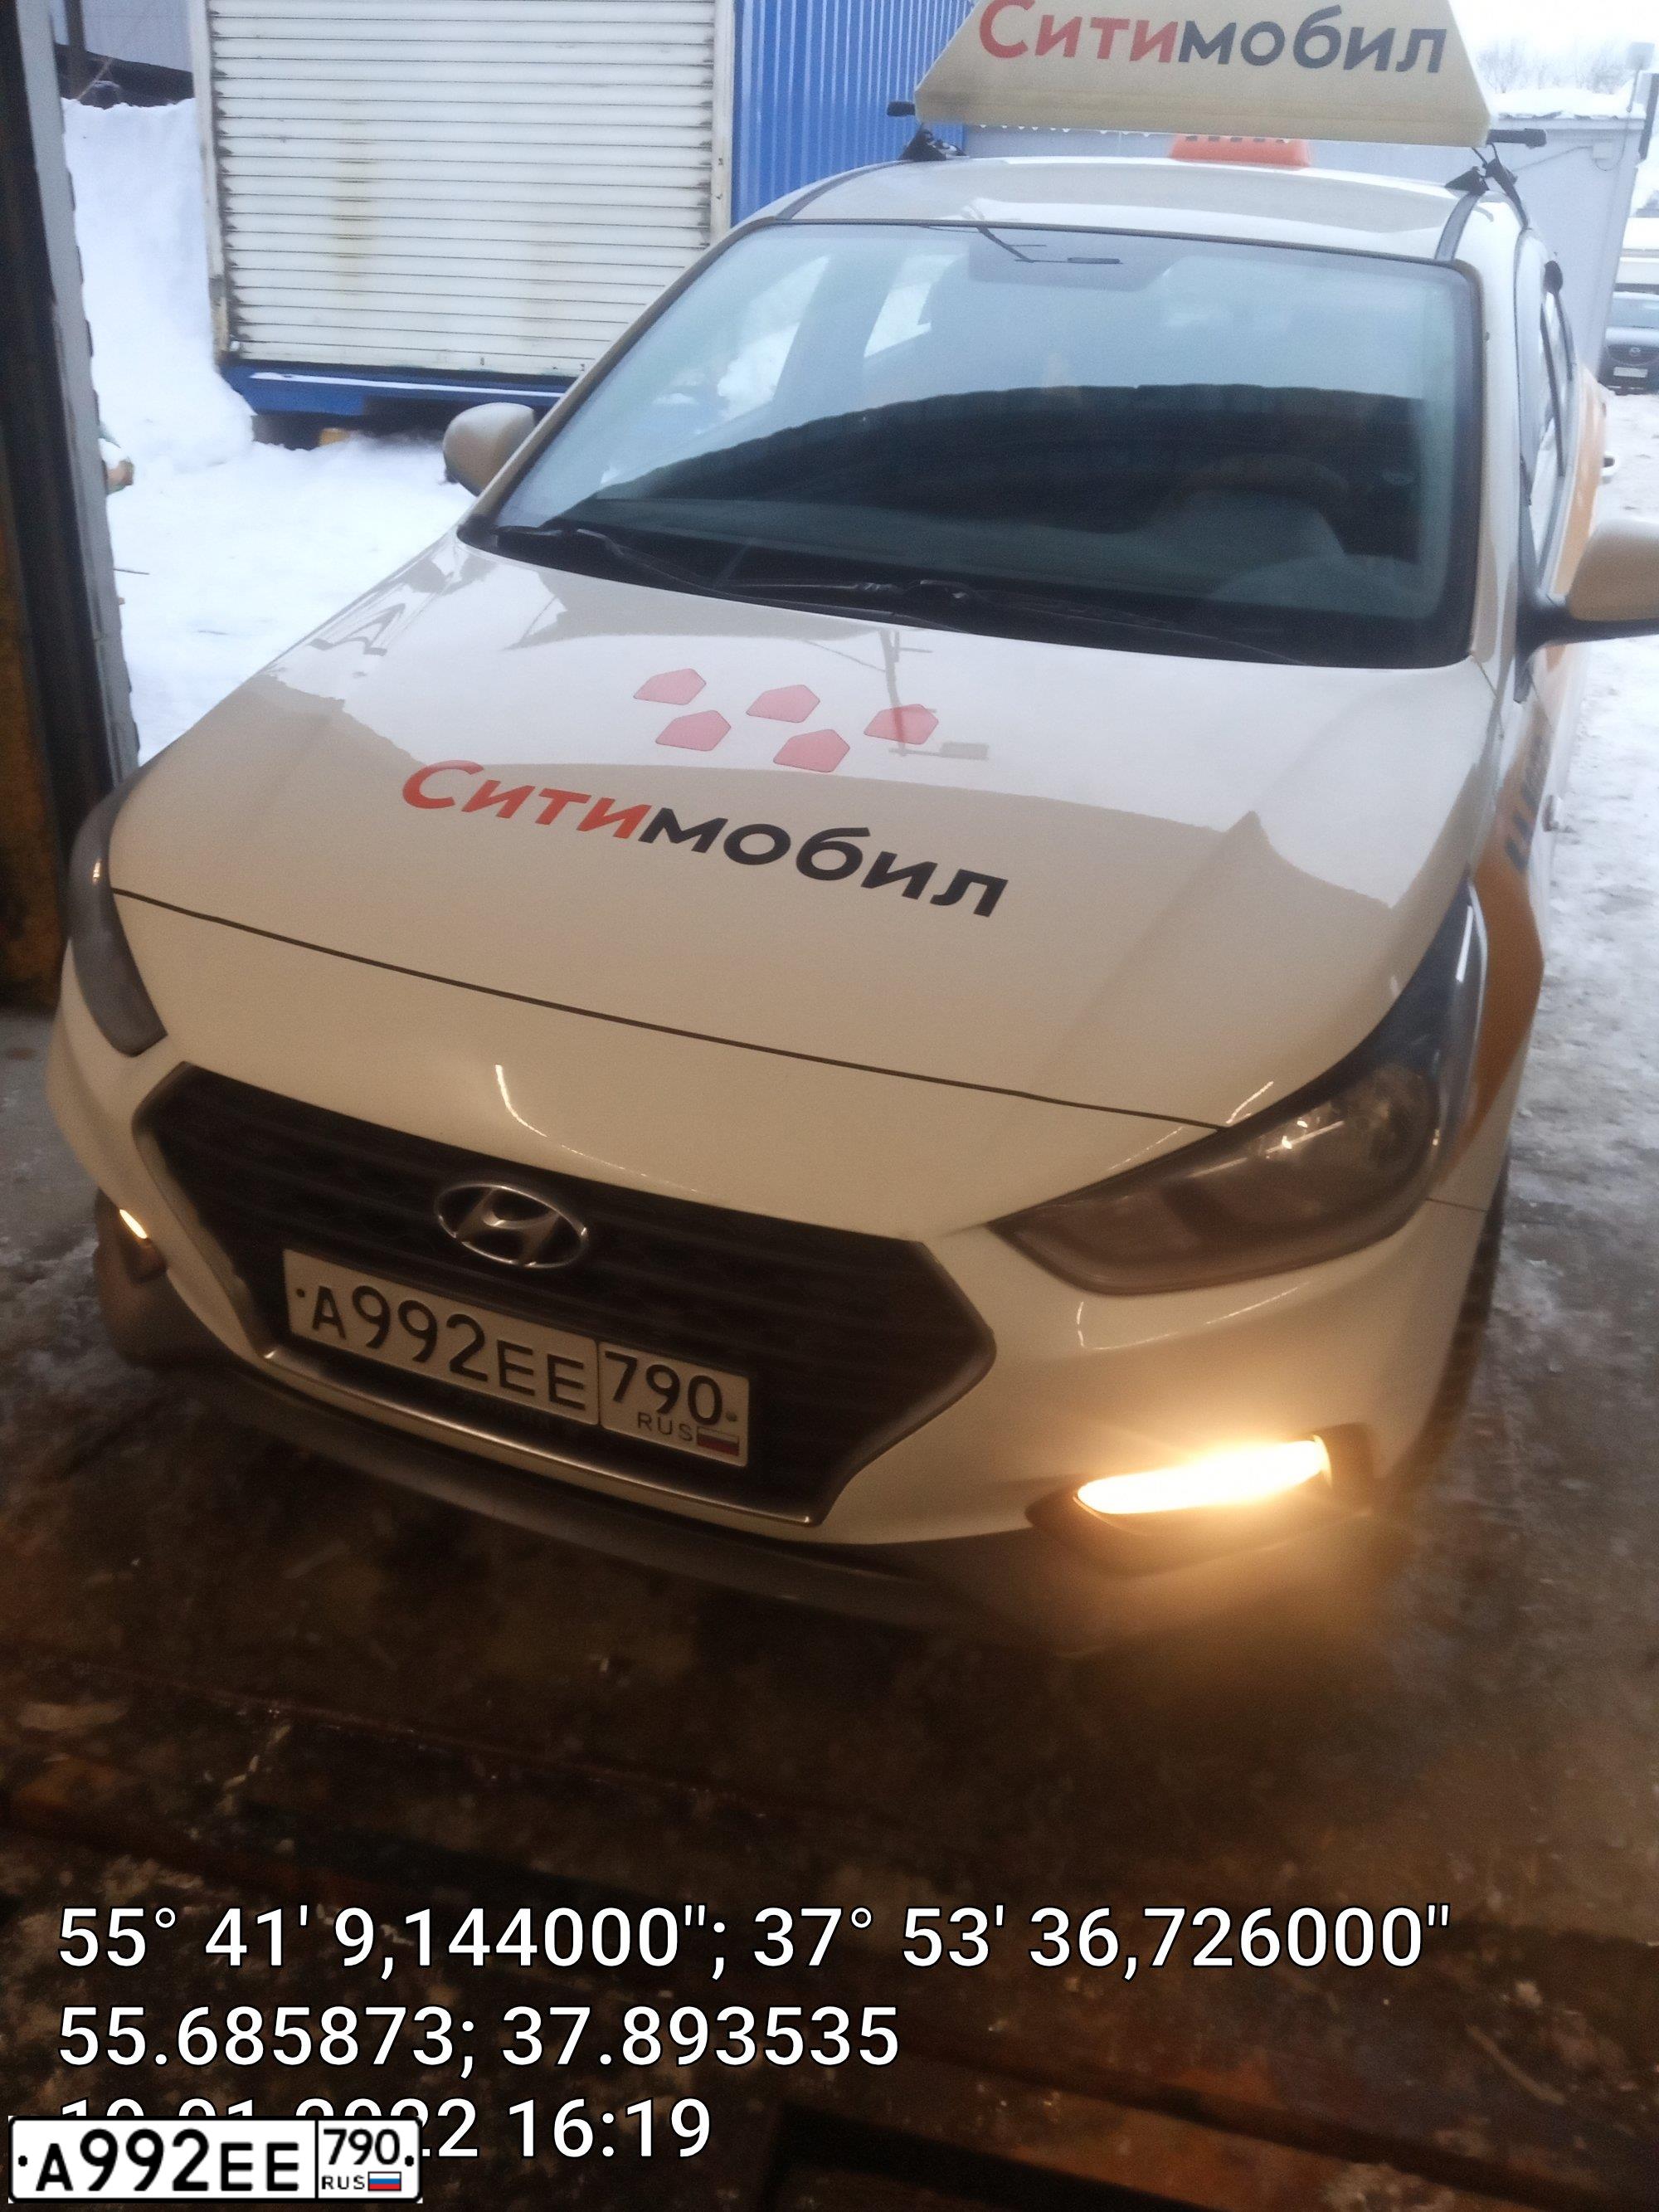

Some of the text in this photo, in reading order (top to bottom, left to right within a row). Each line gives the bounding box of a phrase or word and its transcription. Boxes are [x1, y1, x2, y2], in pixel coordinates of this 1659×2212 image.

[979, 0, 1447, 73] Ситимобил
[401, 759, 1009, 918] Ситимобил
[604, 1350, 724, 1426] 790
[636, 1411, 693, 1443] RUS
